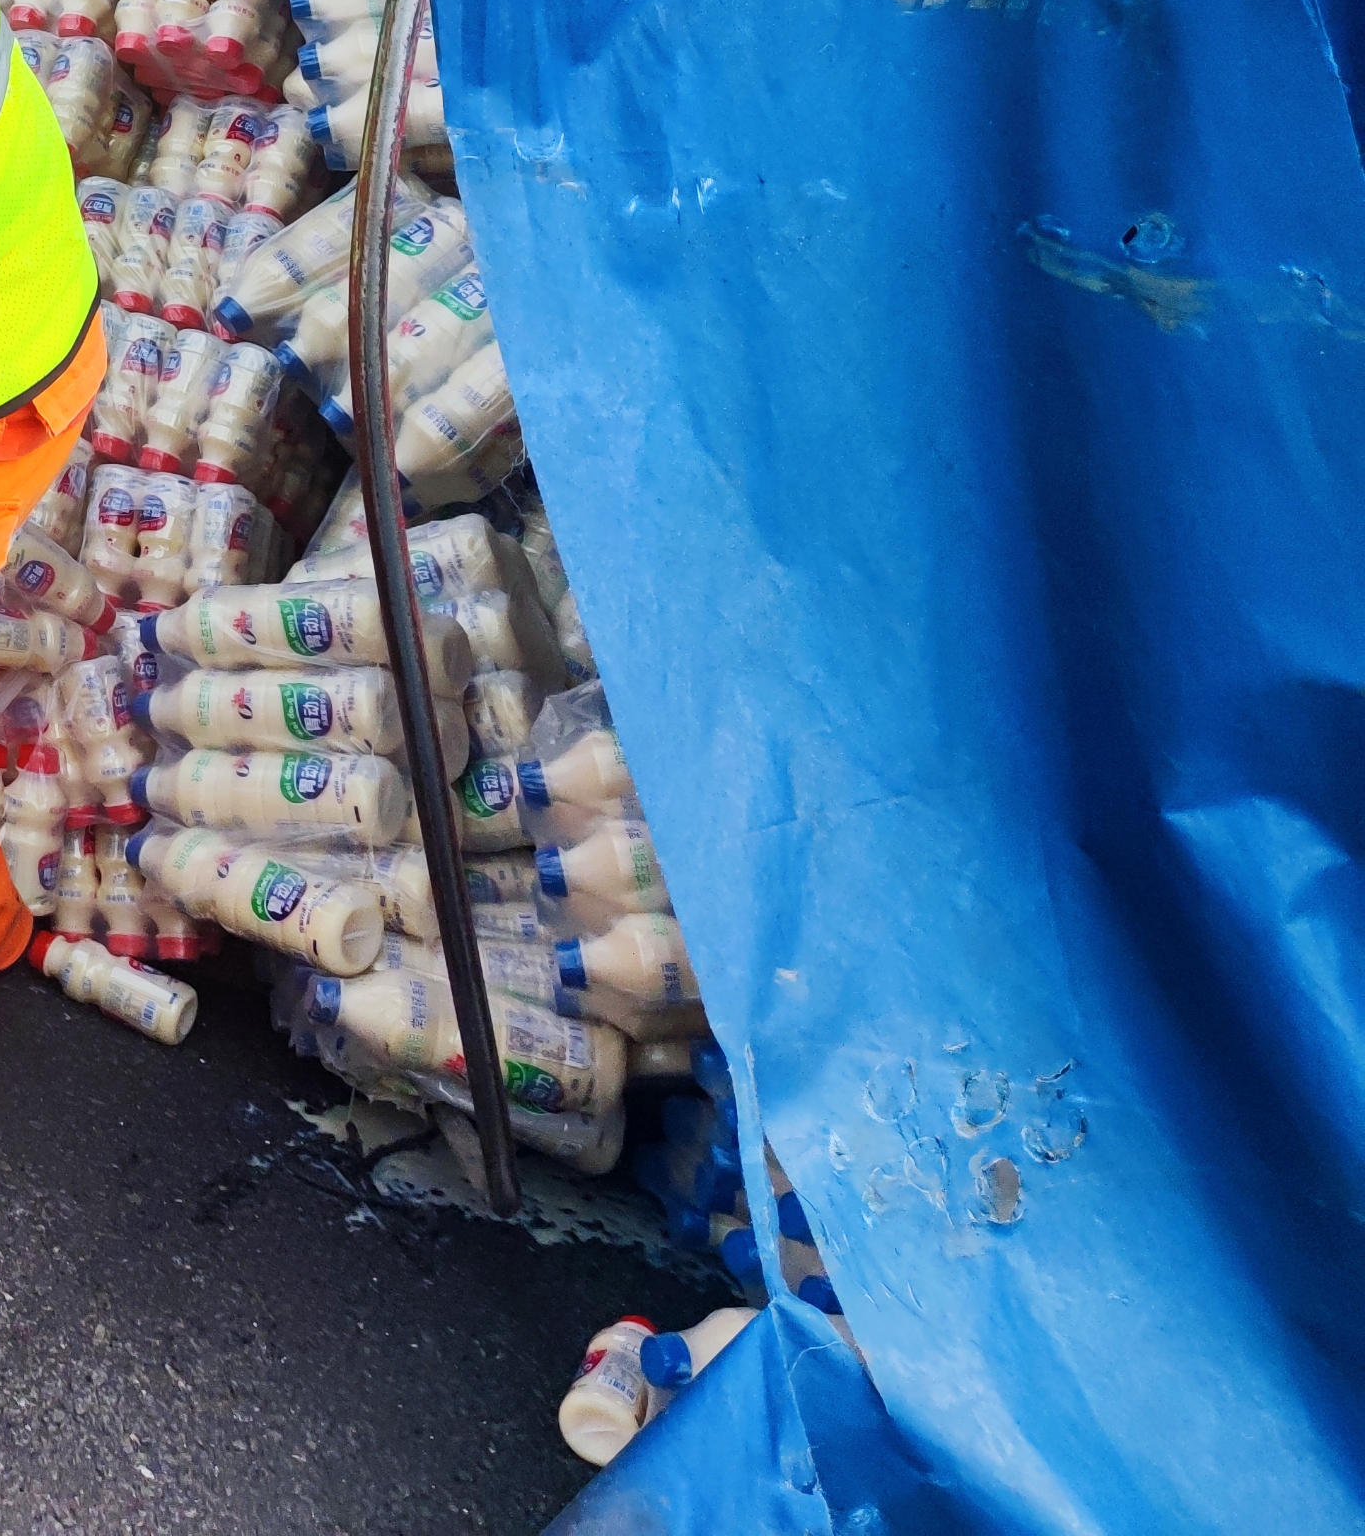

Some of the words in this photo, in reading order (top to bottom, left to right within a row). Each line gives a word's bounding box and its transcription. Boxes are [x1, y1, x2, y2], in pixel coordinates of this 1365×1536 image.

[288, 614, 299, 639] dong
[302, 601, 322, 651] 胃动力
[303, 686, 323, 733] 胃动力
[298, 755, 324, 795] 胃动力
[481, 763, 505, 807] 胃动力
[267, 871, 302, 915] 胃动力
